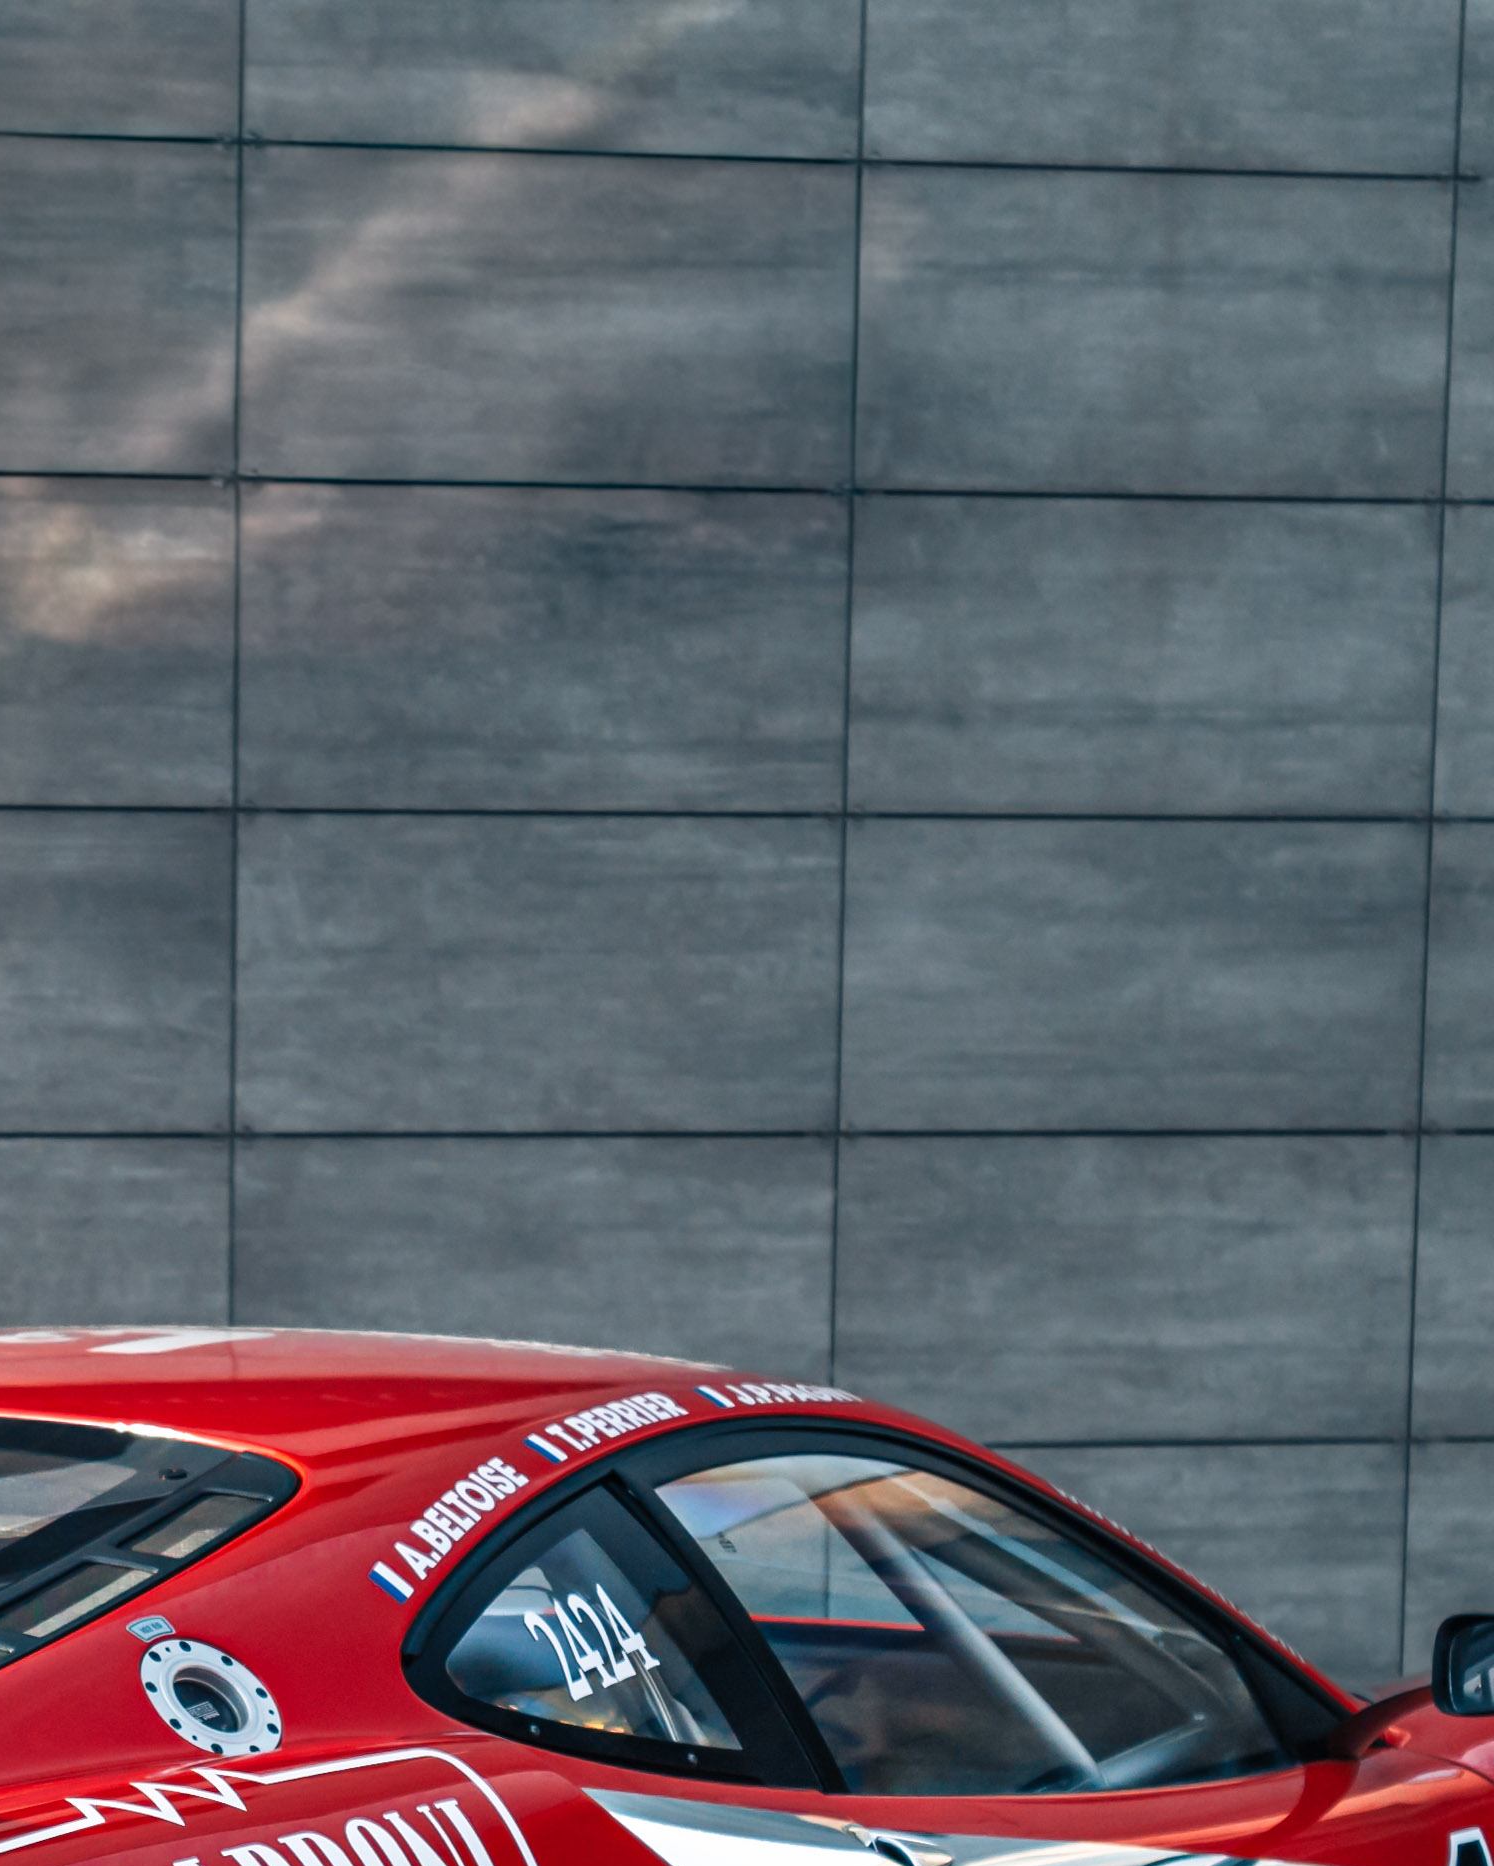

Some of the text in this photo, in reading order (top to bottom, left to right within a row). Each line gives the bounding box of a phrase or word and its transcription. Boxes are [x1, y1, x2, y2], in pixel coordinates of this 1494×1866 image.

[544, 1391, 689, 1452] T.PERRIER
[393, 1456, 529, 1580] A.BELTOISE
[524, 1583, 660, 1702] 2424
